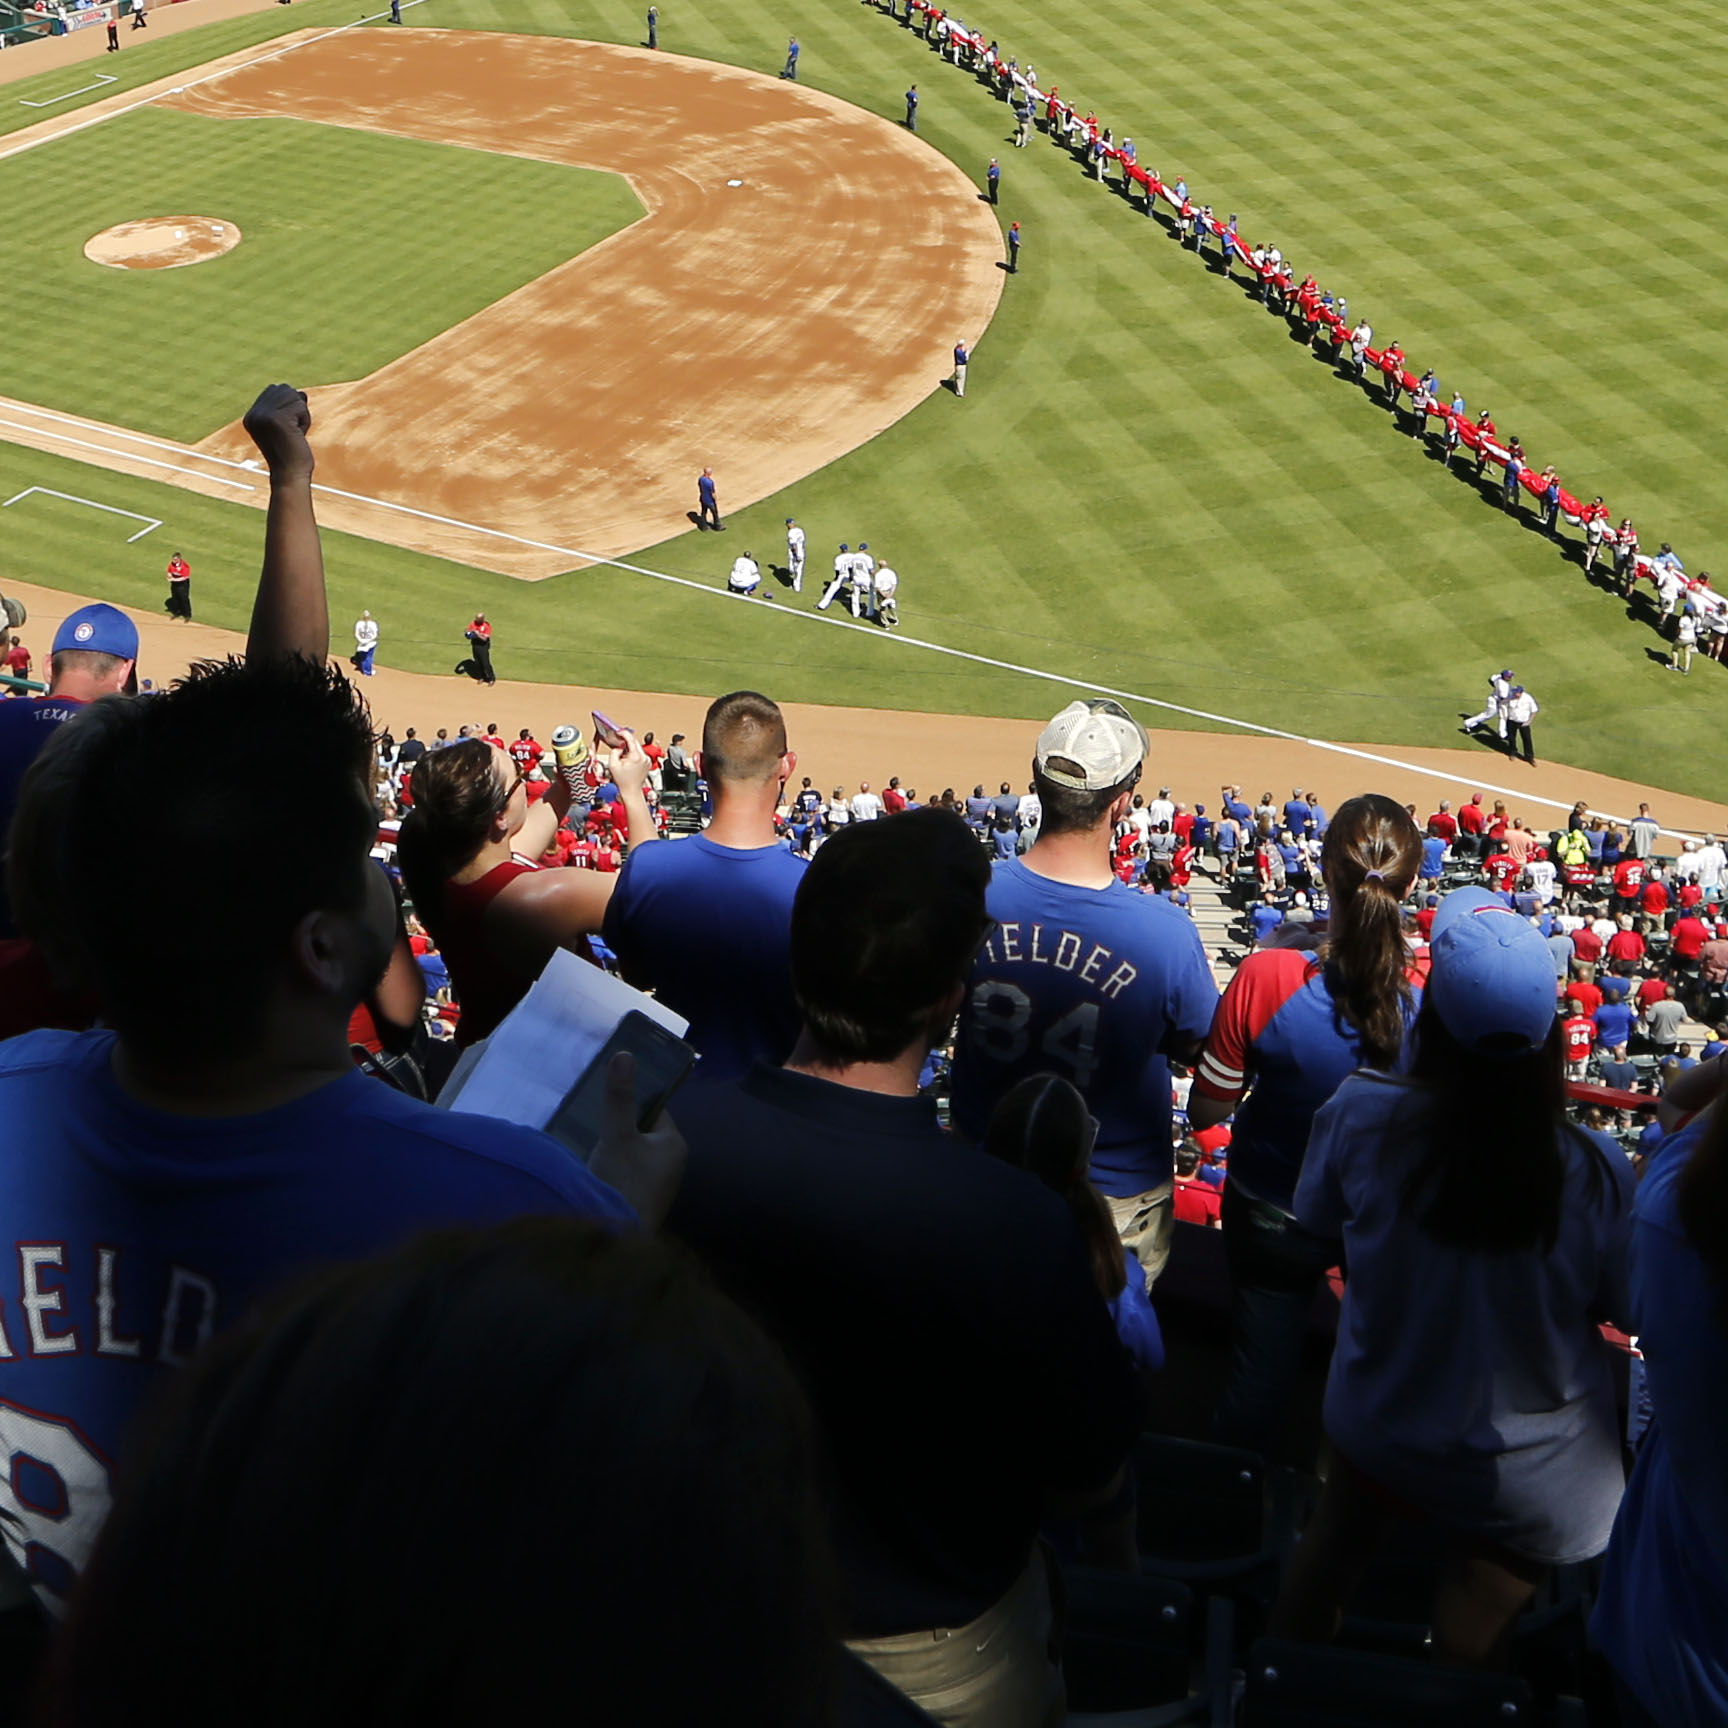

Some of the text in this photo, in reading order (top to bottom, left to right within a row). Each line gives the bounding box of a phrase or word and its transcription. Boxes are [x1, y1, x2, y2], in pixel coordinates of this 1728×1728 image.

[1497, 868, 1506, 879] 5
[1536, 874, 1549, 887] 17
[1313, 898, 1329, 911] 29
[975, 922, 1137, 1000] IELDER
[972, 980, 1101, 1084] 84
[1571, 1033, 1589, 1046] 84
